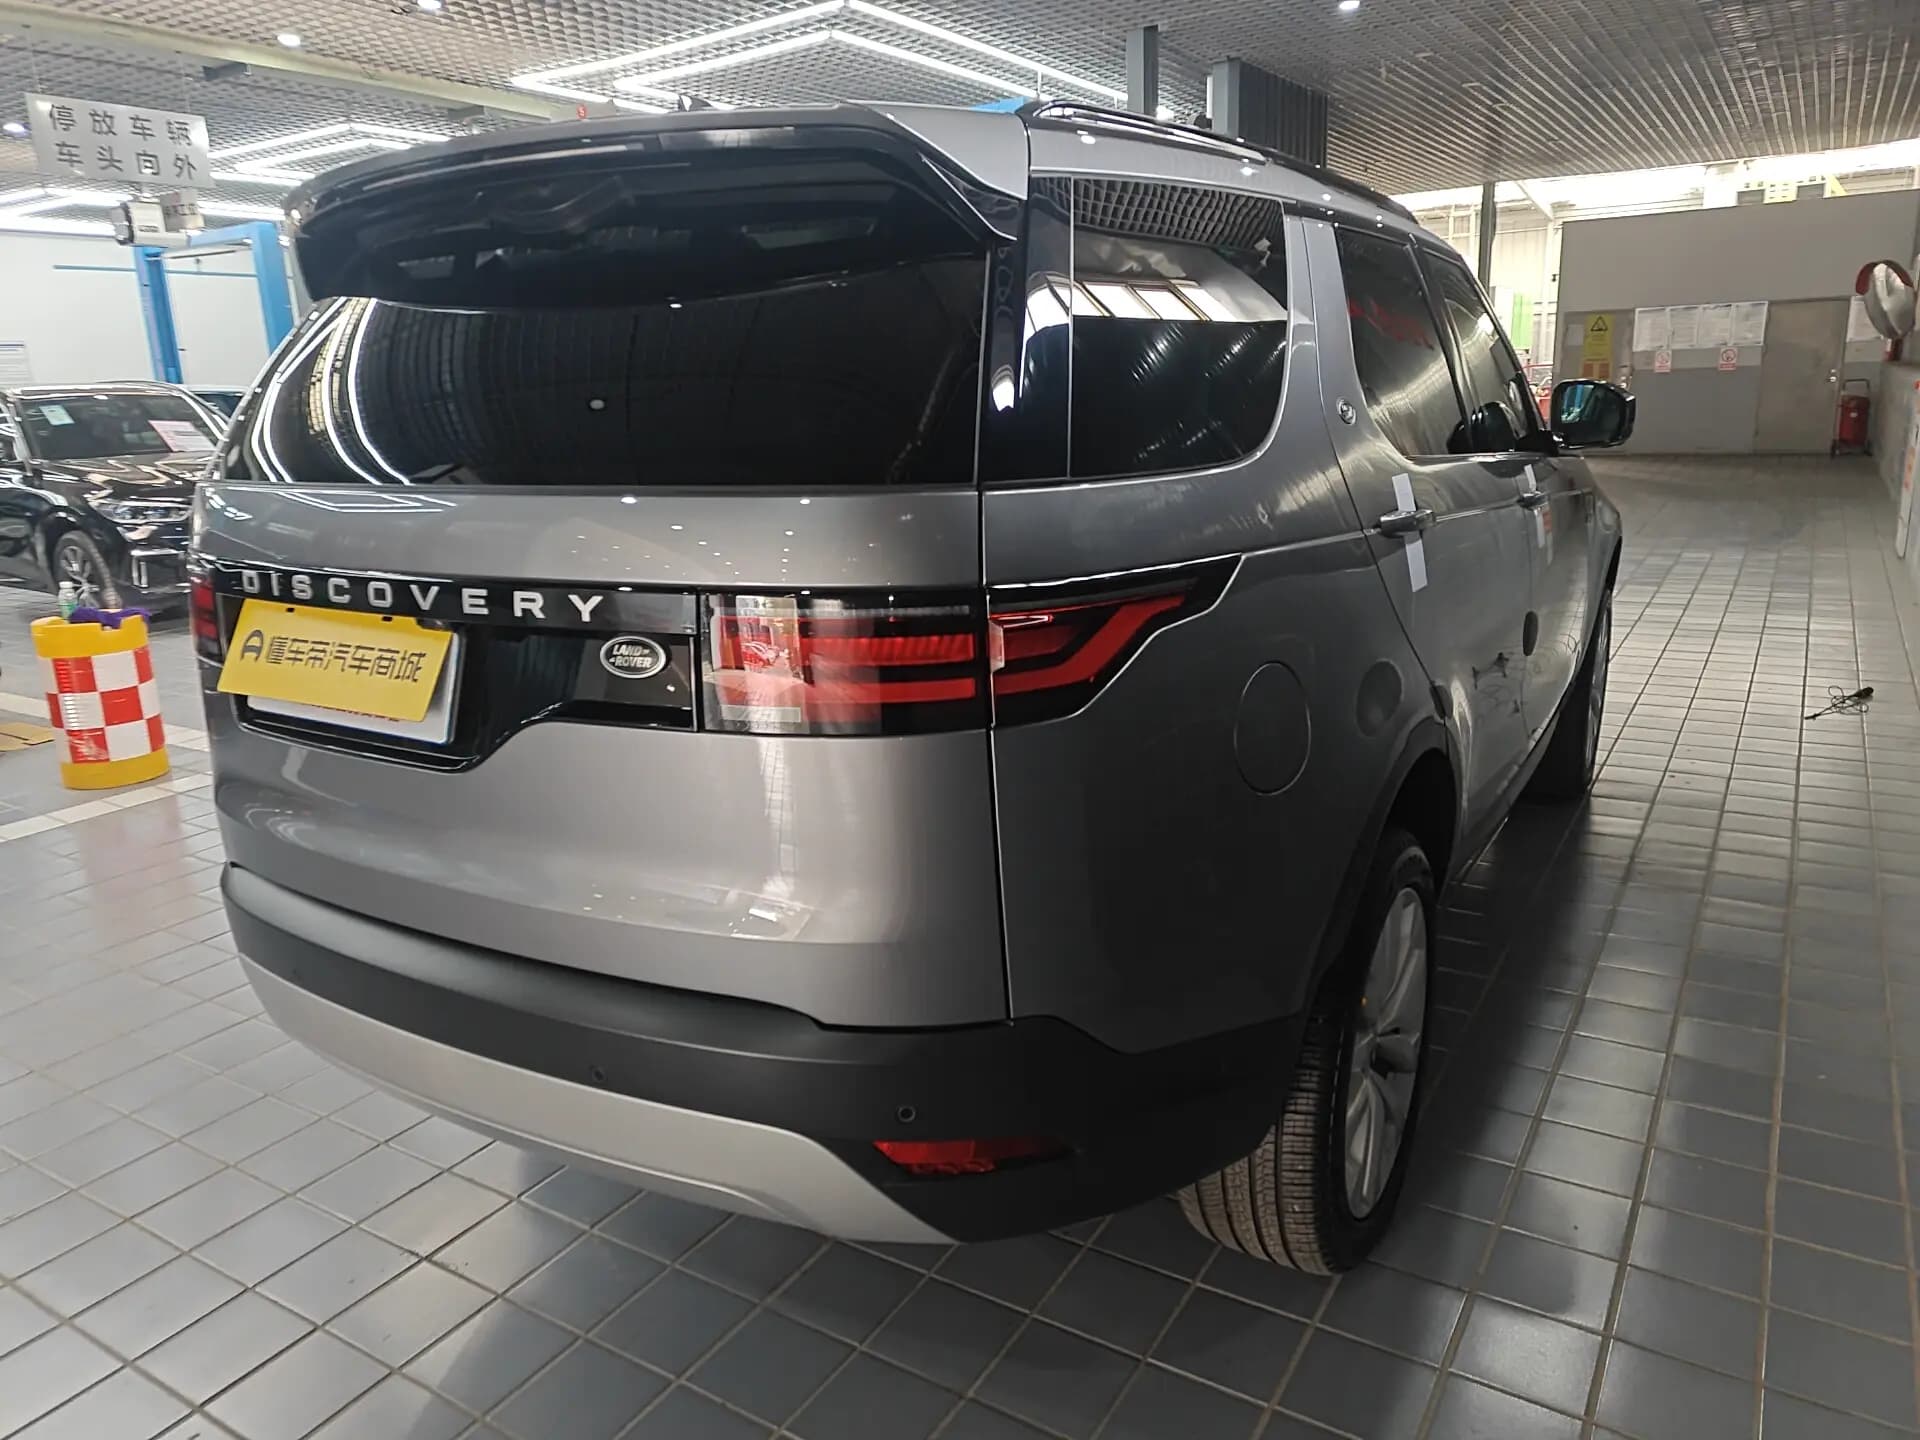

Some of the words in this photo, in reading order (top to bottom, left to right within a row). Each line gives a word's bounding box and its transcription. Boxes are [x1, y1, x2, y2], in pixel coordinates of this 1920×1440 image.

[49, 103, 192, 146] 停放车辆
[54, 141, 197, 180] 车头向外
[241, 571, 603, 623] DISCOVERY
[612, 644, 643, 656] LAND
[614, 655, 653, 668] ROVER
